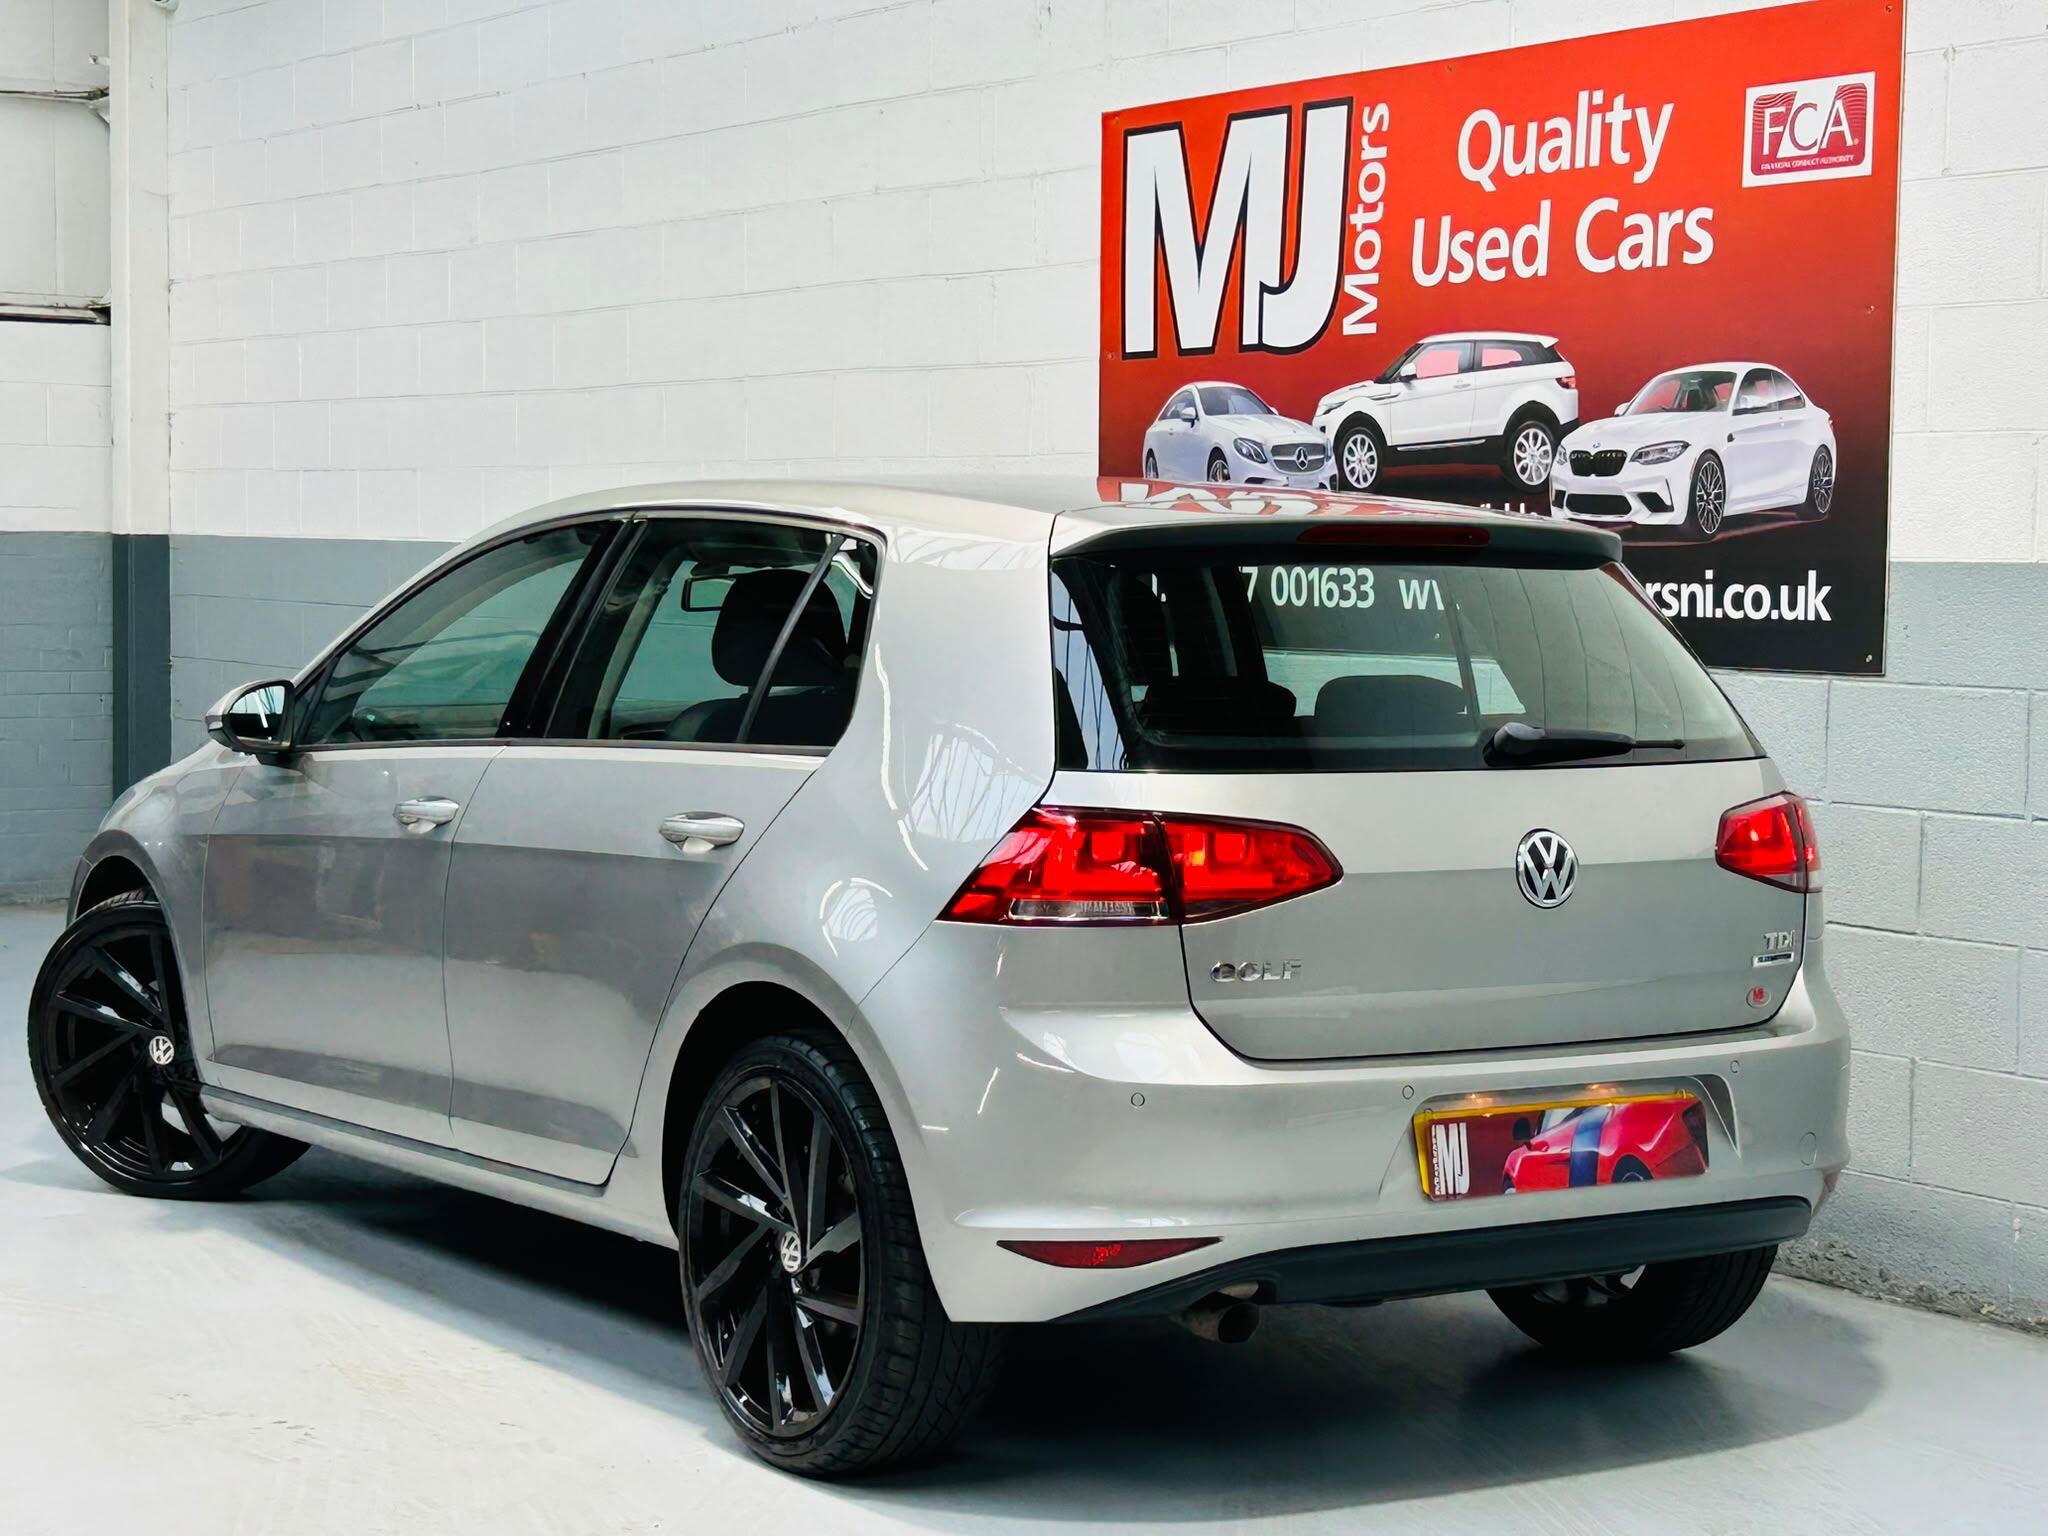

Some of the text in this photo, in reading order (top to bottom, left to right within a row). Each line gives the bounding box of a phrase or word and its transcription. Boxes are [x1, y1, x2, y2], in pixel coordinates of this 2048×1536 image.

[1457, 88, 1675, 192] Quality
[1762, 98, 1855, 156] FCA
[1122, 96, 1353, 360] MJ
[1343, 102, 1389, 335] Motors
[1411, 196, 1715, 288] Used Cars
[1239, 565, 1259, 603] 7
[1270, 565, 1375, 608] 001633
[1210, 960, 1302, 983] GOLF
[1764, 929, 1796, 951] TDI
[1435, 1121, 1470, 1195] MJ
